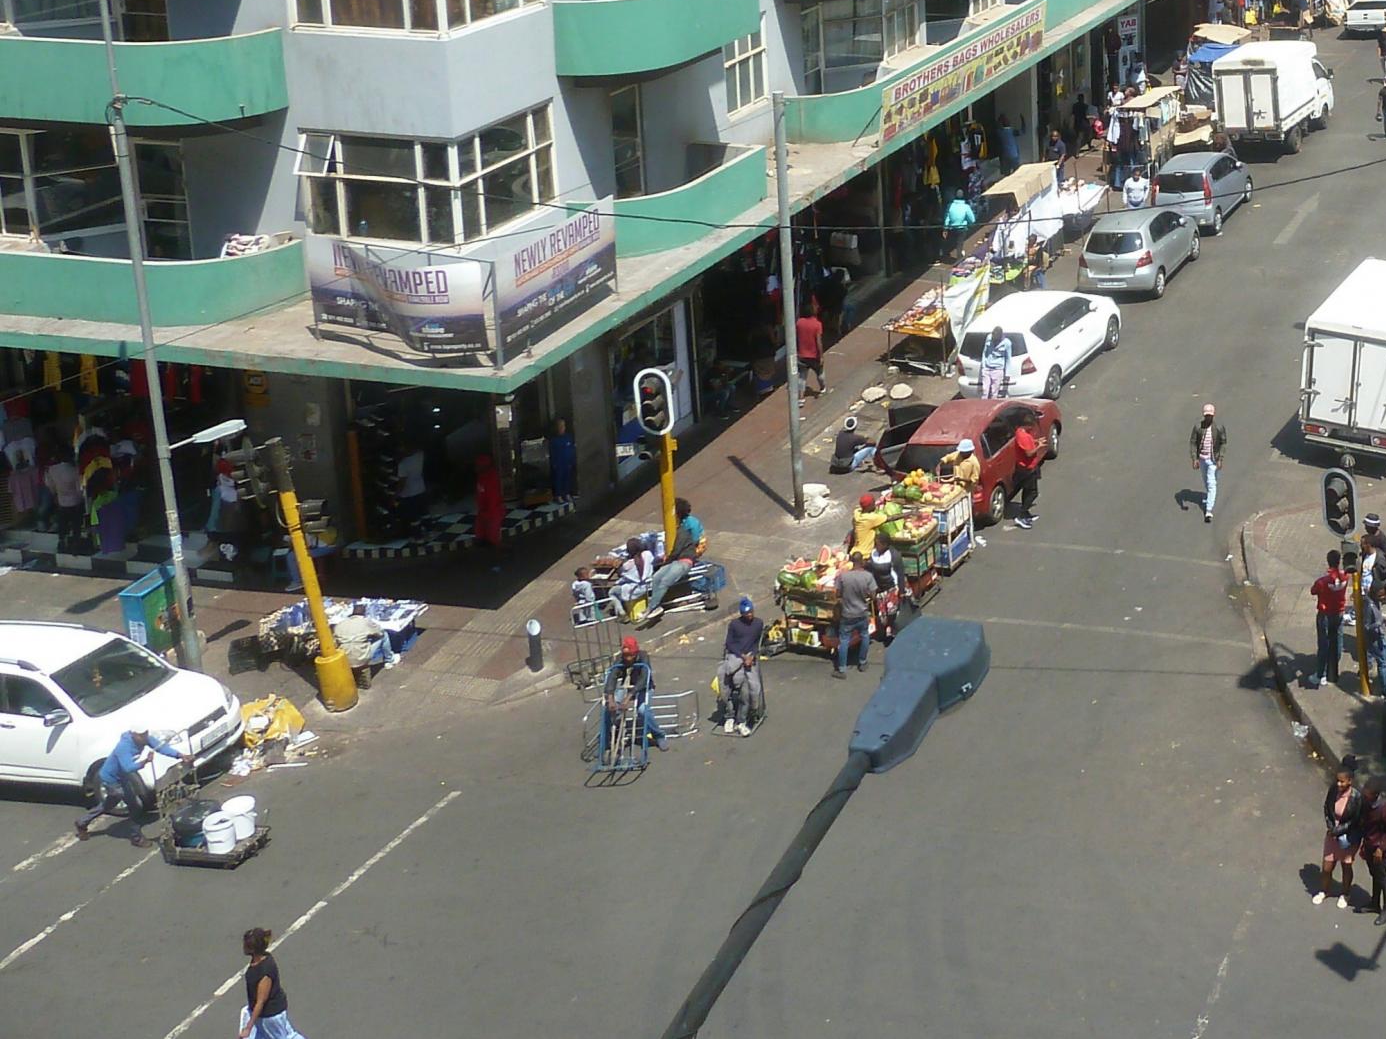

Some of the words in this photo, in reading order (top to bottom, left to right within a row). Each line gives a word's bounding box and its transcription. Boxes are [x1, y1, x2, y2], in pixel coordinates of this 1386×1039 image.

[893, 59, 950, 100] BROTHERS
[952, 42, 978, 69] BAGS
[979, 8, 1041, 52] WHOLESALERS
[1120, 18, 1137, 29] YAB
[514, 235, 547, 278] NEWLY
[549, 208, 600, 257] REVAMPED
